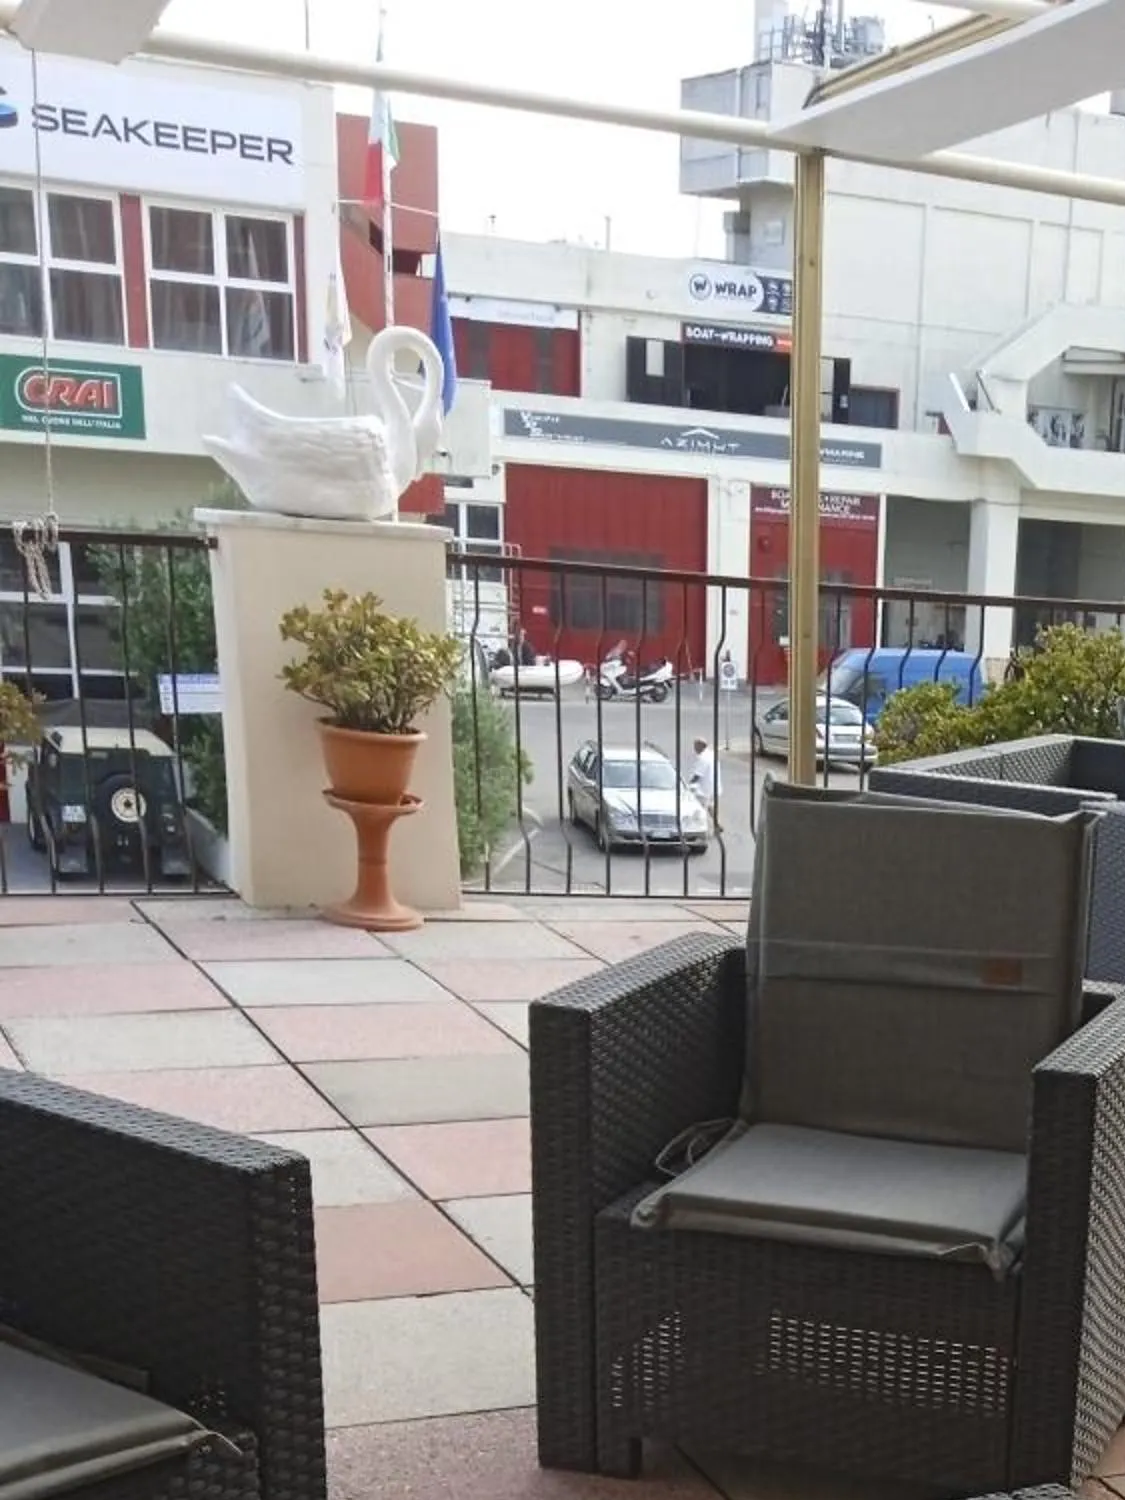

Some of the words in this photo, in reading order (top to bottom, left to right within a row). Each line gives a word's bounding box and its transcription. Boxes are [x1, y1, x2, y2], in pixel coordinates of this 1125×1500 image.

[32, 103, 295, 166] SEAKEEPER
[714, 280, 758, 298] WRAP
[685, 325, 775, 347] BOAT-WRAPPING
[23, 374, 113, 409] CRAI
